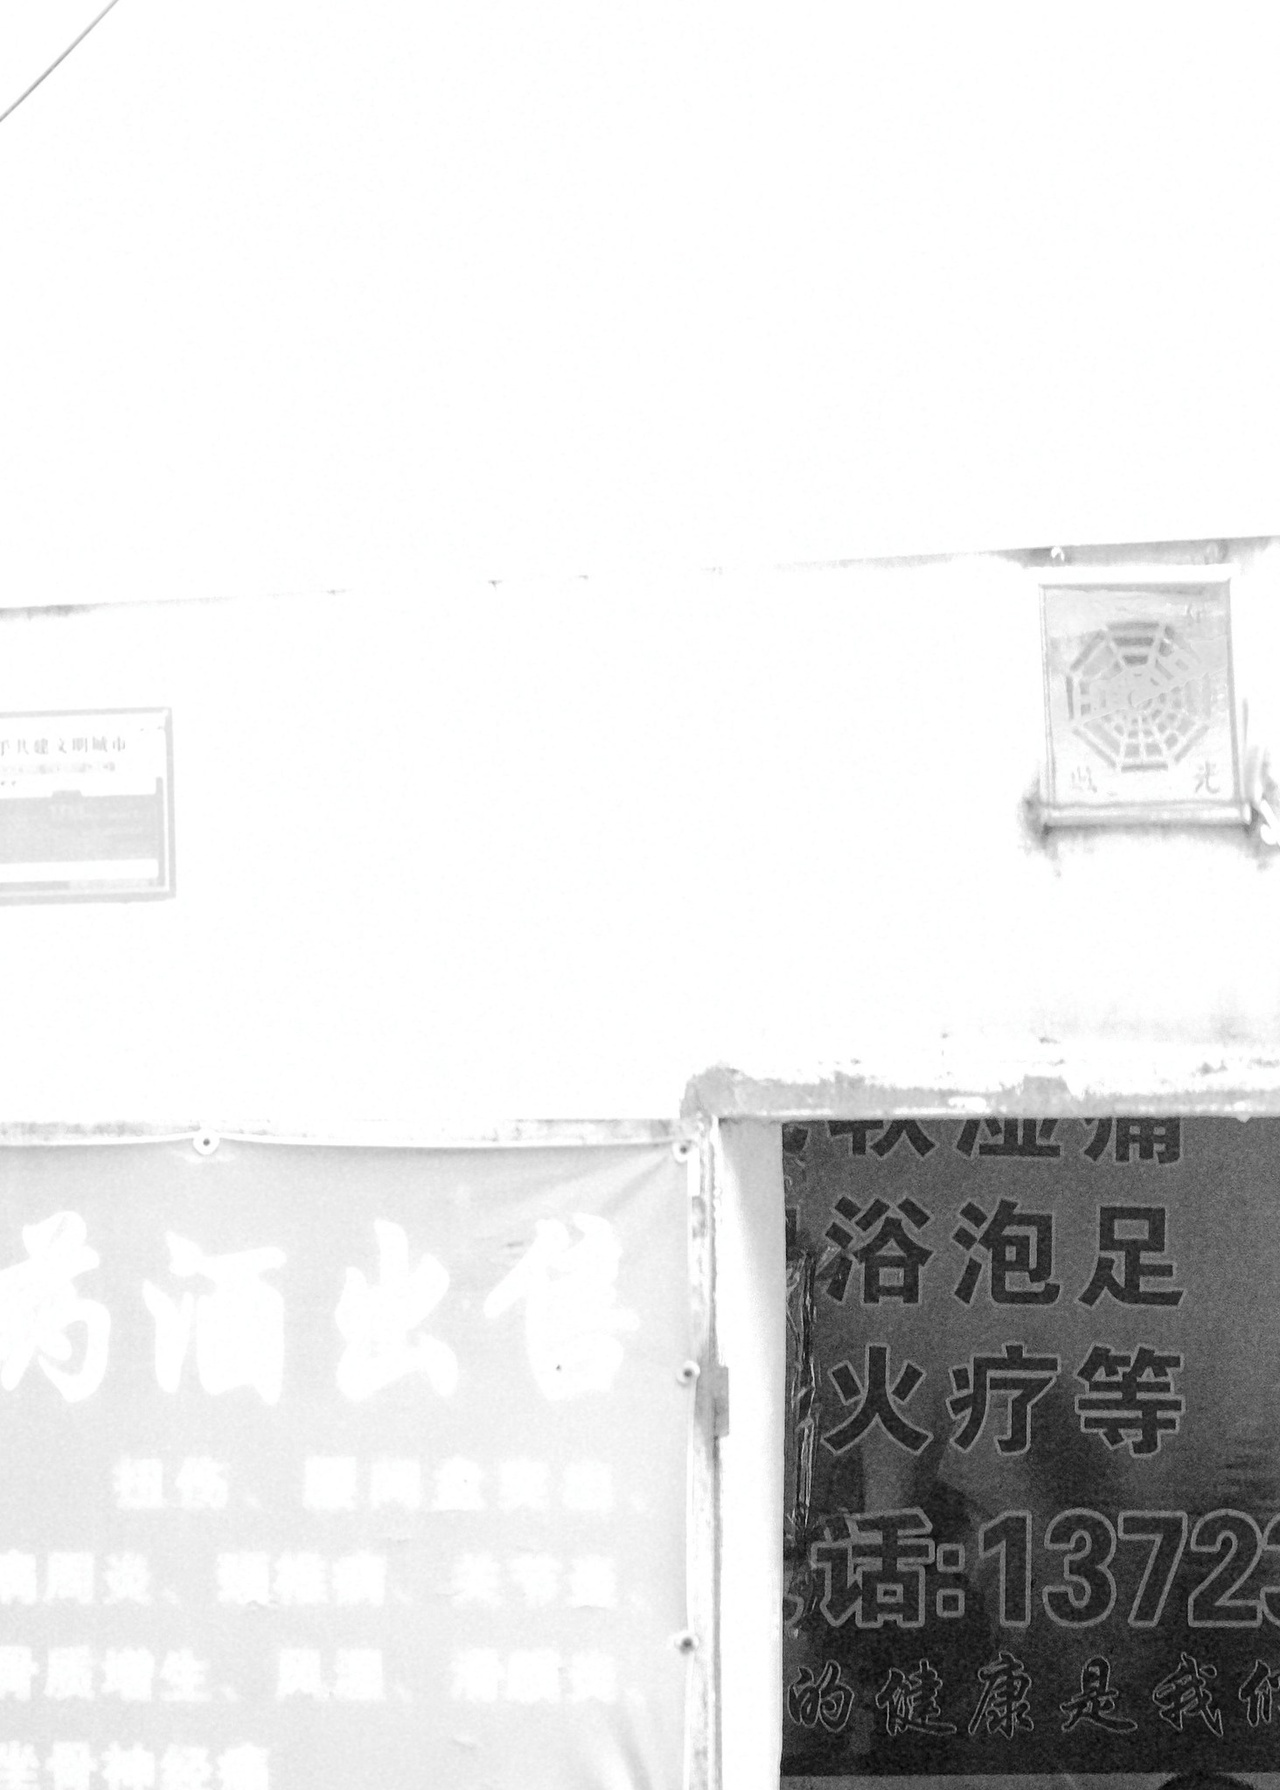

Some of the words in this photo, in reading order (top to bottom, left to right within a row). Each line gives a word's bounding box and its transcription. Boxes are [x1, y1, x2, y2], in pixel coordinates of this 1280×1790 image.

[824, 1194, 1189, 1308] 浴泡足
[821, 1343, 1186, 1458] 火疗等
